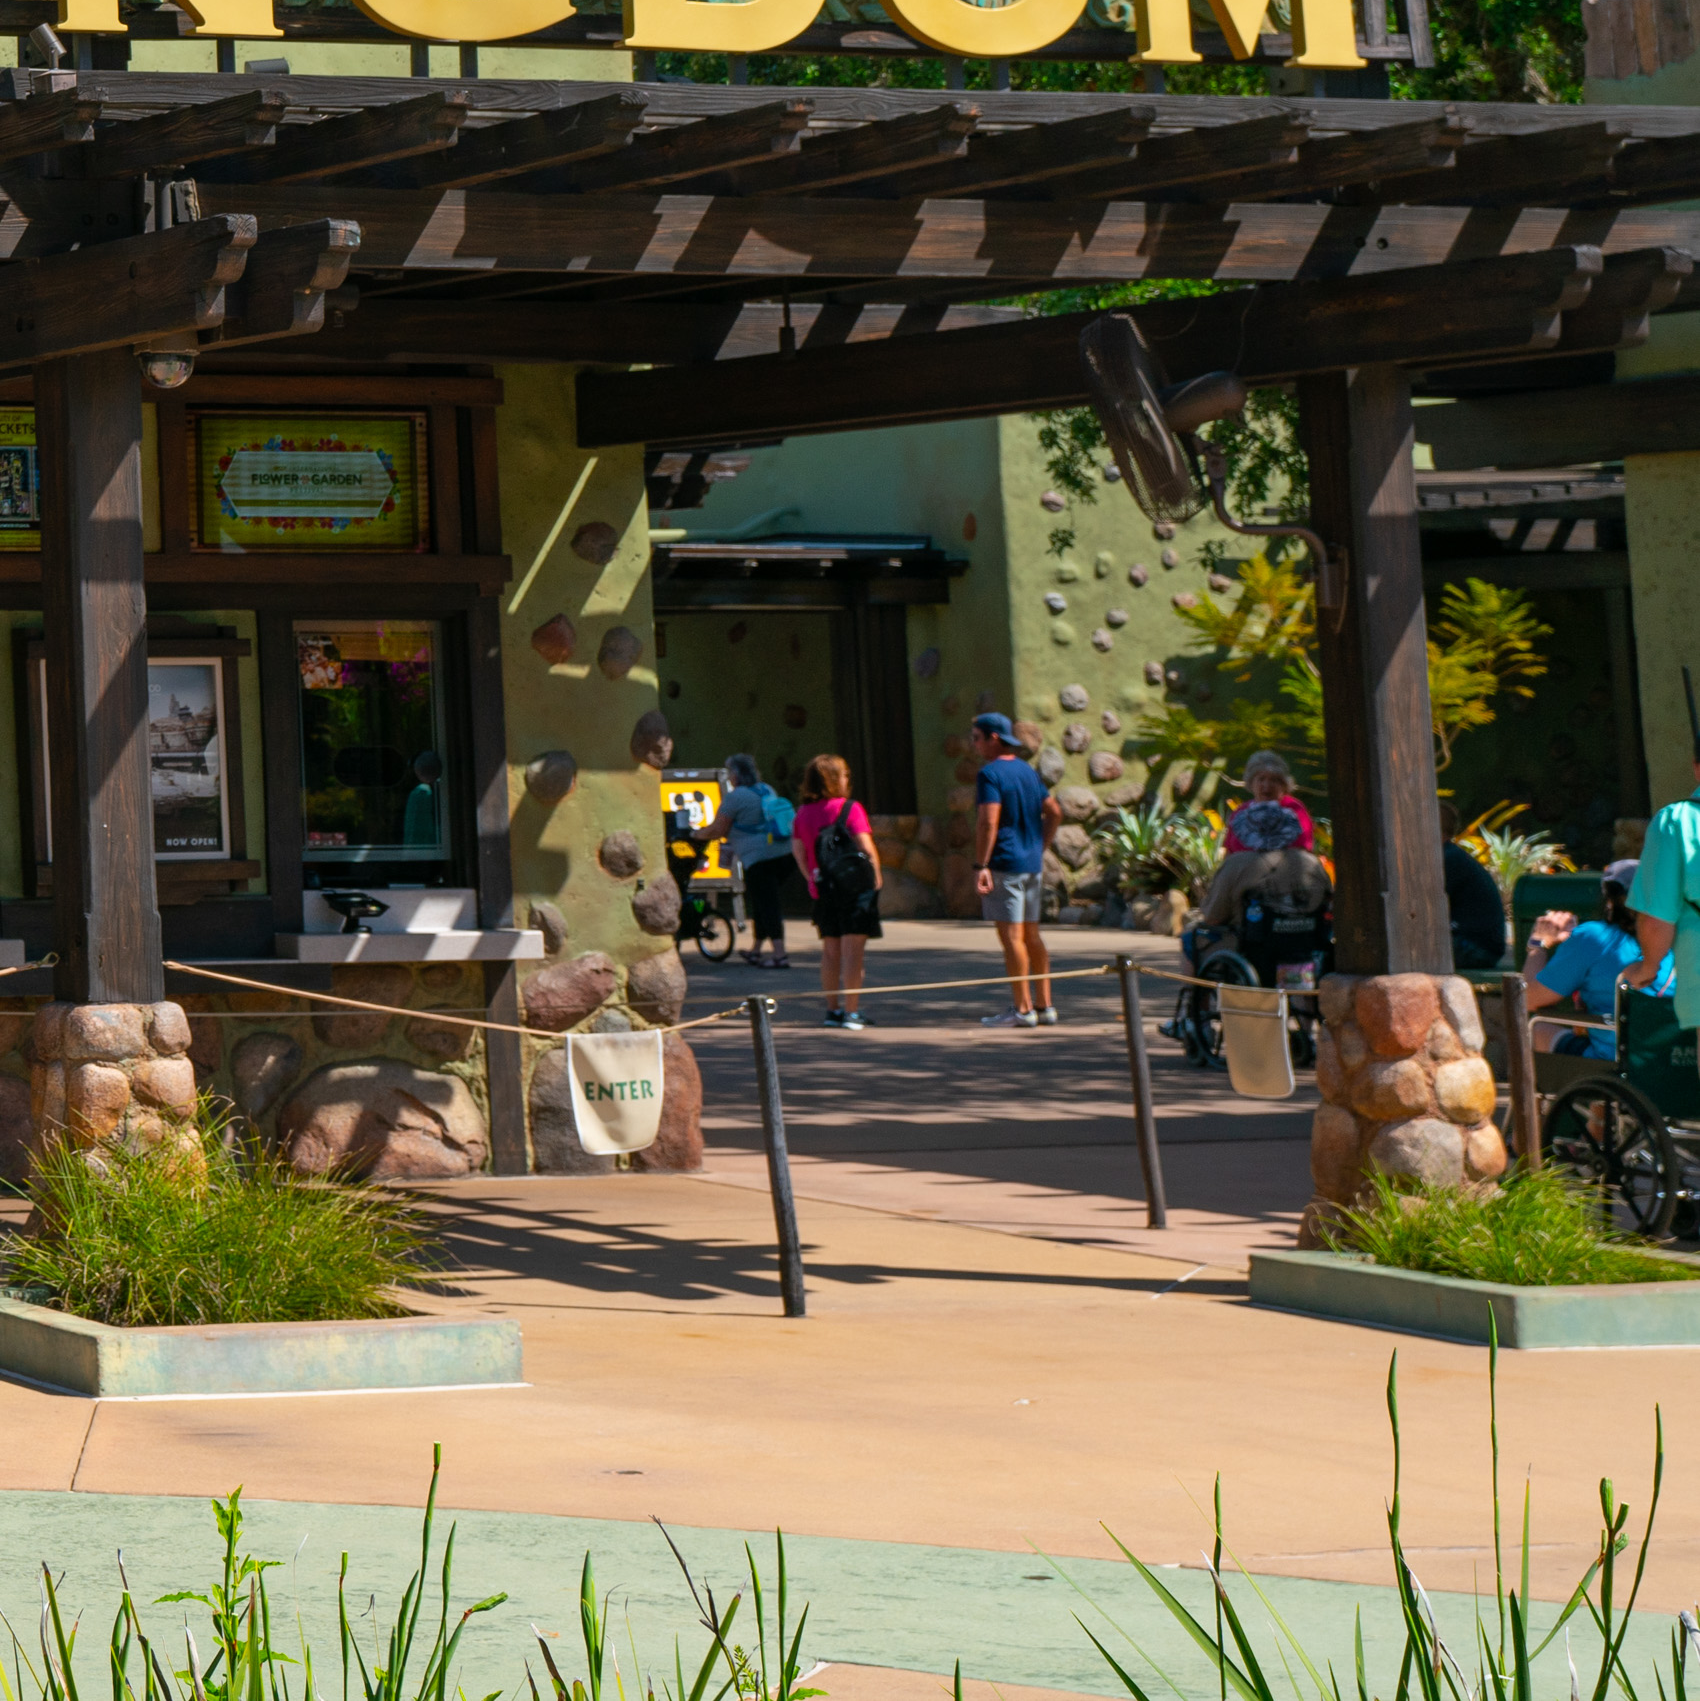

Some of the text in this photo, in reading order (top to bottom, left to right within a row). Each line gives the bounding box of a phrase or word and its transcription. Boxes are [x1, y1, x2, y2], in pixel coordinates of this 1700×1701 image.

[251, 474, 362, 485] FLOWER GARDEN
[166, 837, 218, 846] NOW OPEN!
[584, 1079, 654, 1102] ENTER
